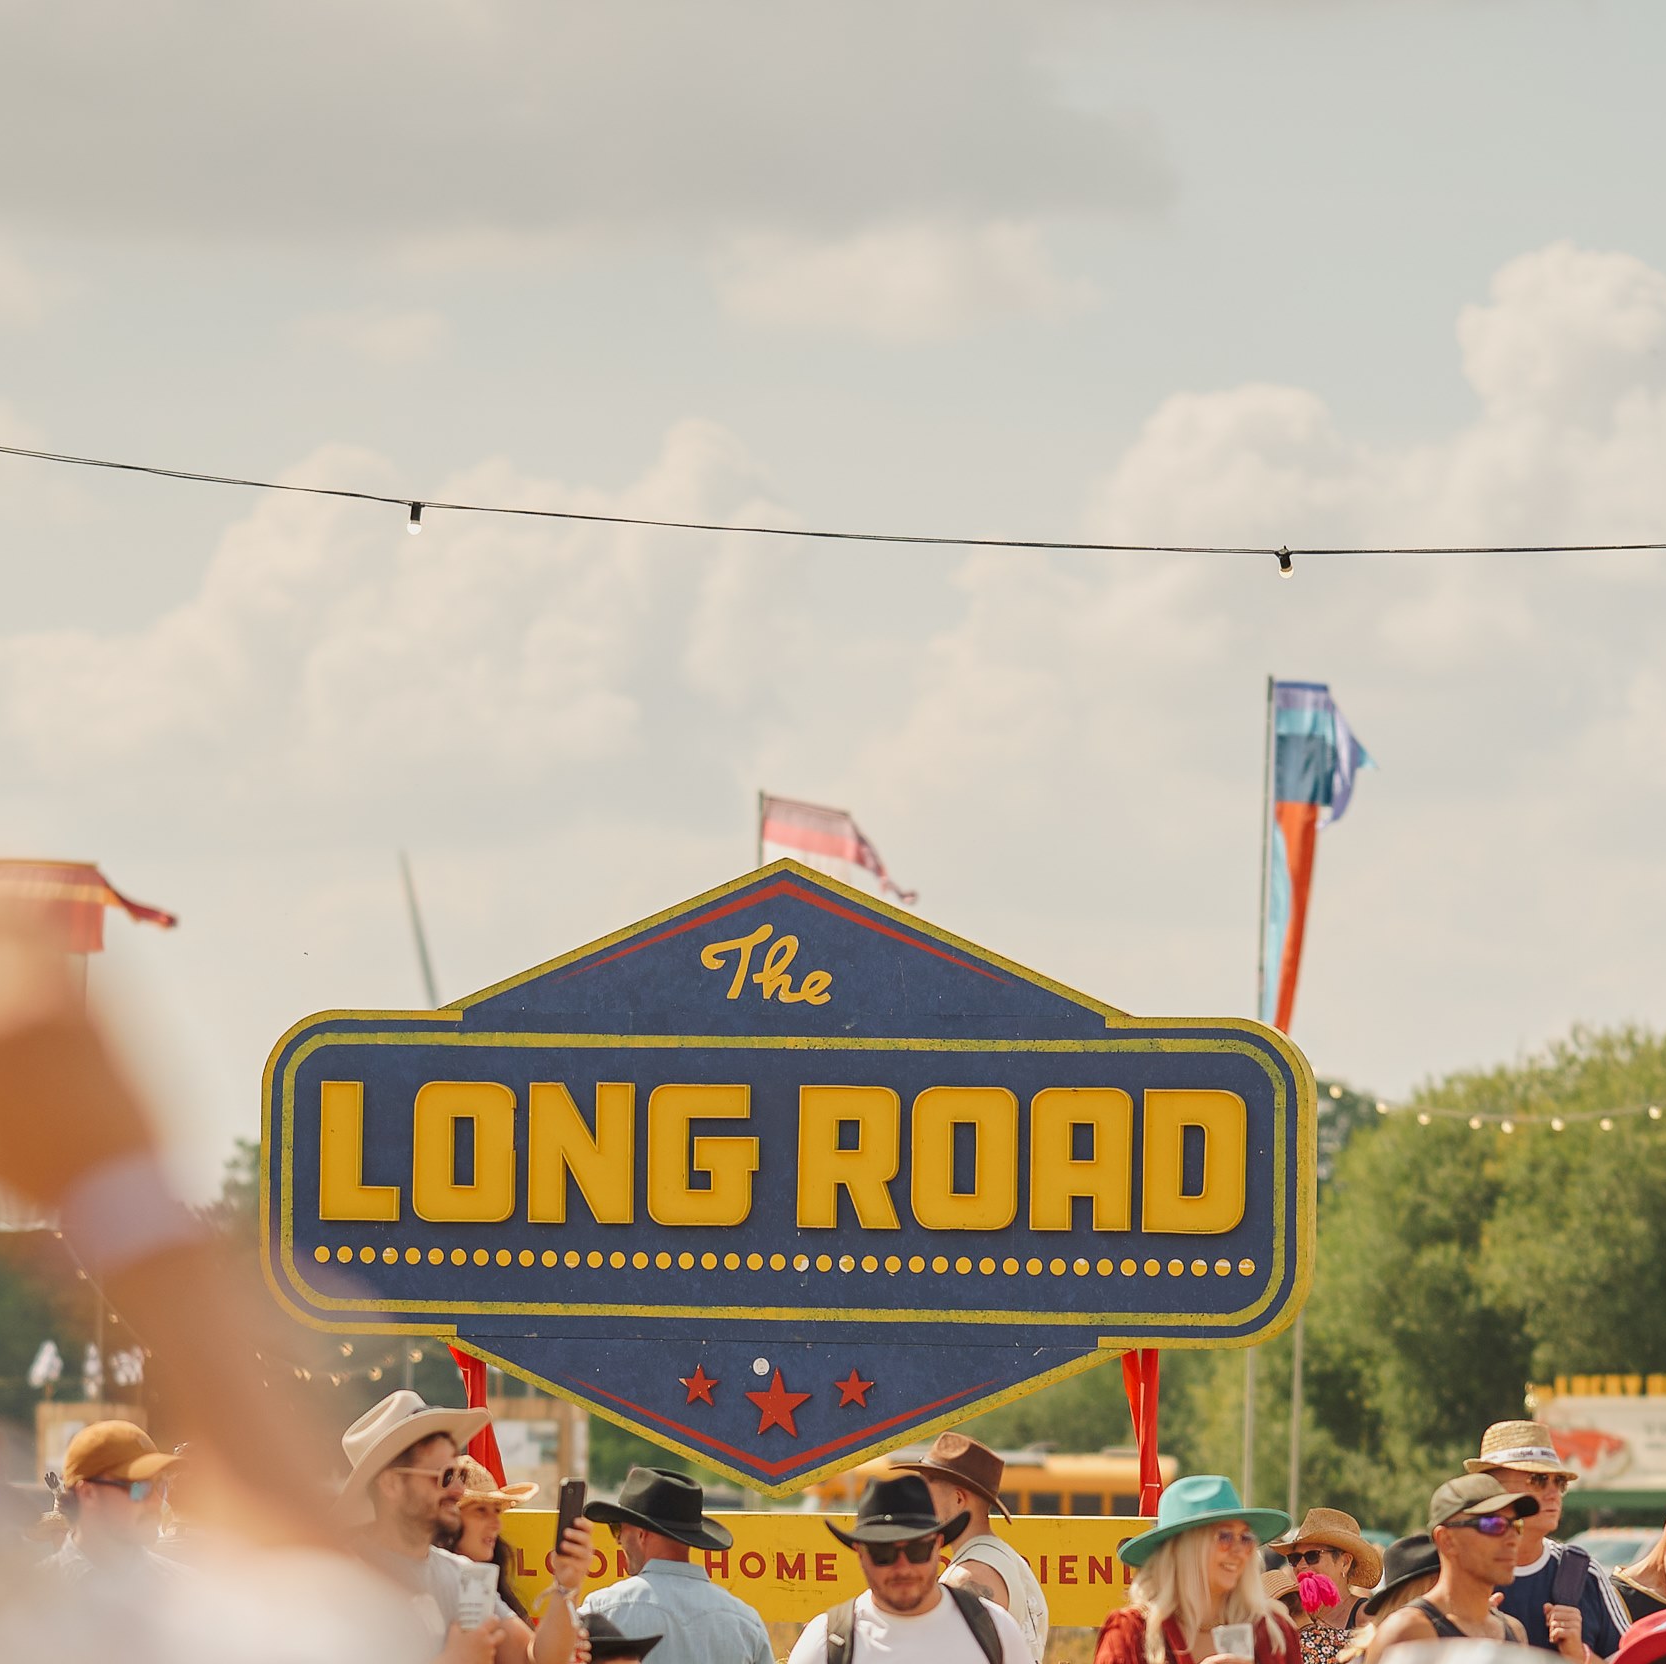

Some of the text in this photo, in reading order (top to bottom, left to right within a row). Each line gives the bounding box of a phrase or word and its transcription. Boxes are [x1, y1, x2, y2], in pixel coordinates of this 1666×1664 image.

[700, 923, 832, 1006] The
[318, 1080, 1247, 1236] LONG ROAD
[704, 1549, 839, 1582] HOME
